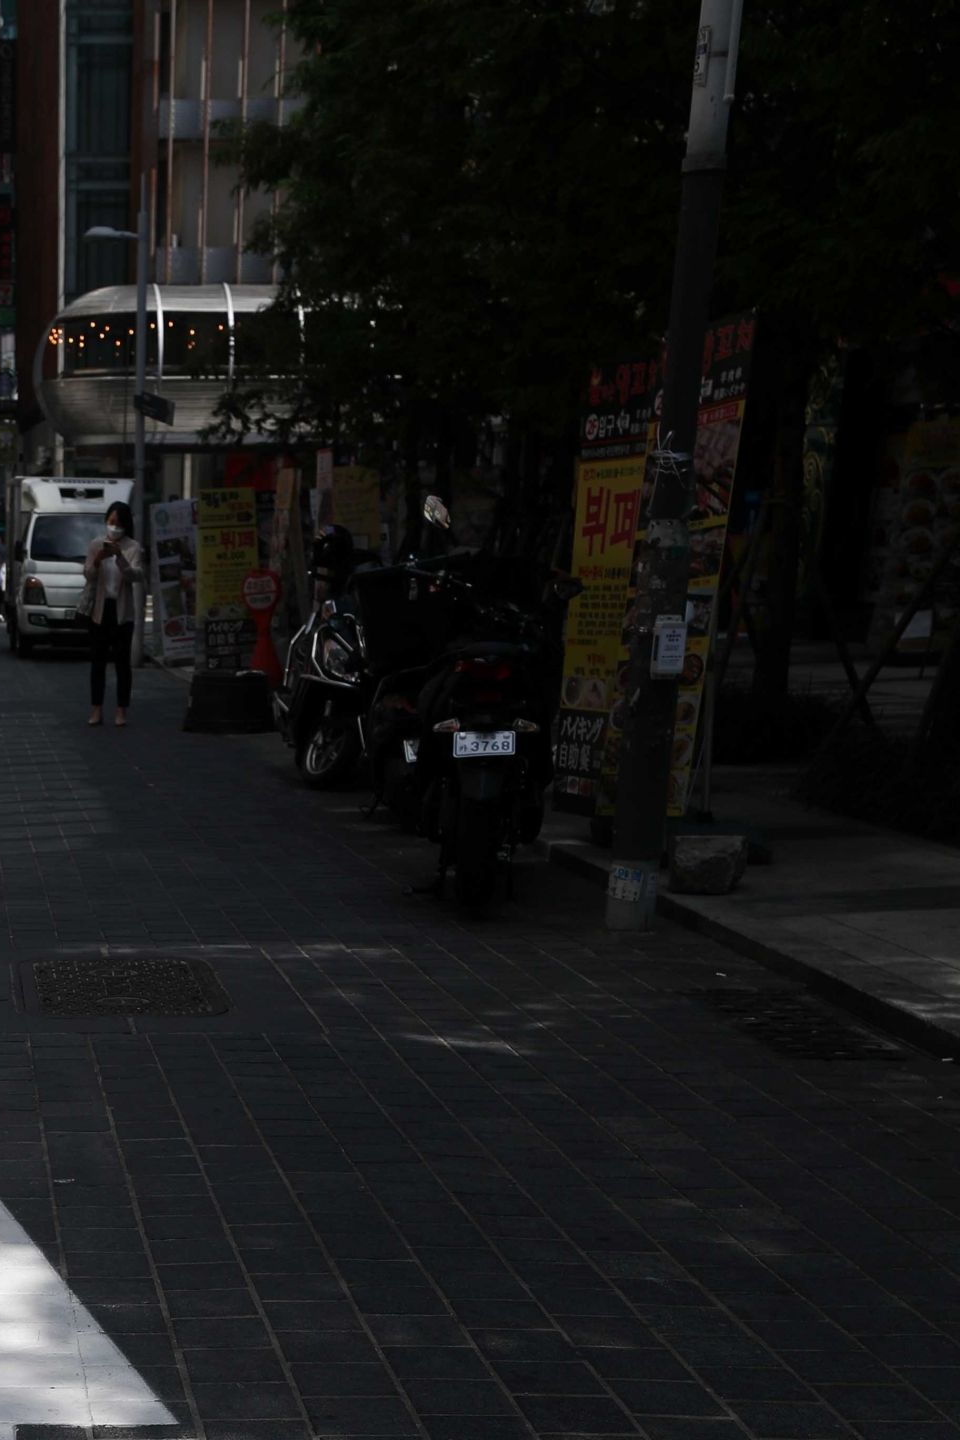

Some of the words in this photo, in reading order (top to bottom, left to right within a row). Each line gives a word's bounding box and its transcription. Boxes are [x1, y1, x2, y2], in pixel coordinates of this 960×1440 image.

[561, 714, 604, 743] バイキング
[470, 740, 511, 752] 3768
